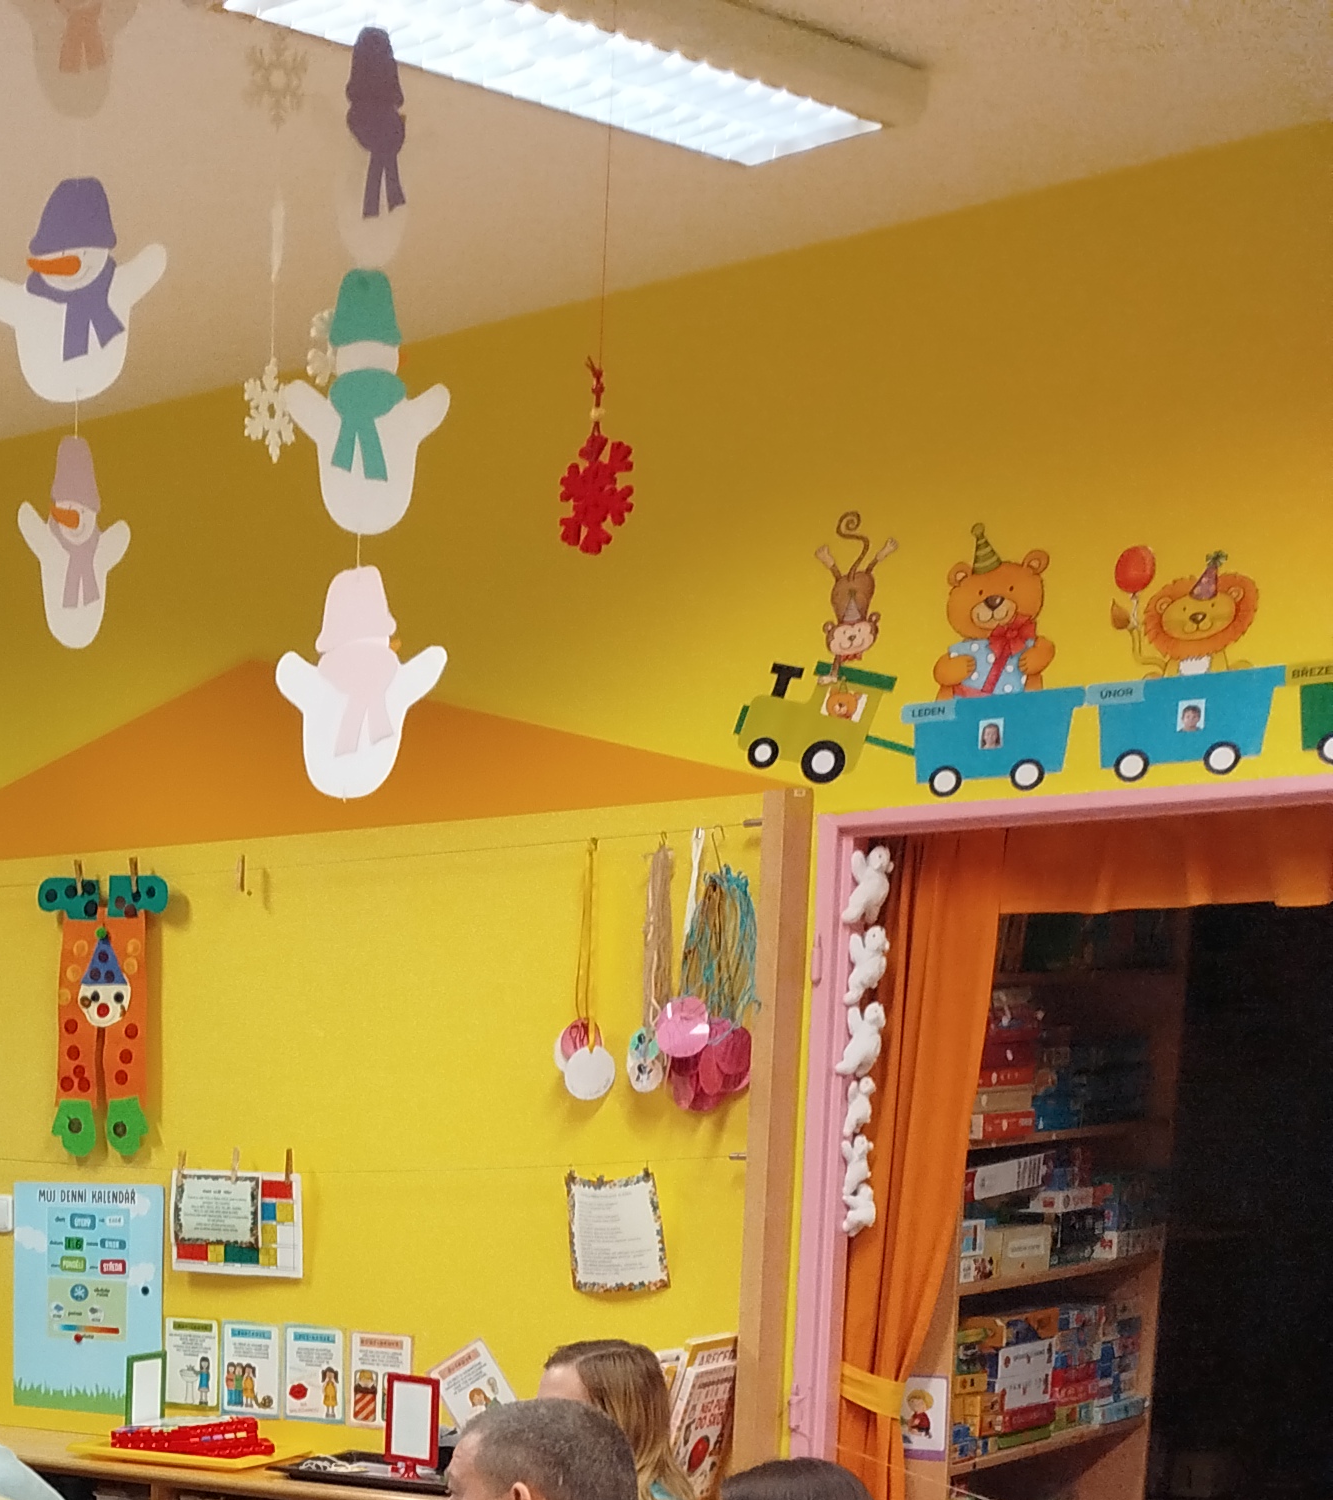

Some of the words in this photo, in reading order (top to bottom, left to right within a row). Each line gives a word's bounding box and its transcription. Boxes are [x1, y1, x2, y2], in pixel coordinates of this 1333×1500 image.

[1100, 687, 1133, 700] ÚNOR
[911, 705, 945, 718] LEDEN
[60, 1187, 87, 1203] DENNÍ
[91, 1187, 136, 1205] KALENDÁŘ
